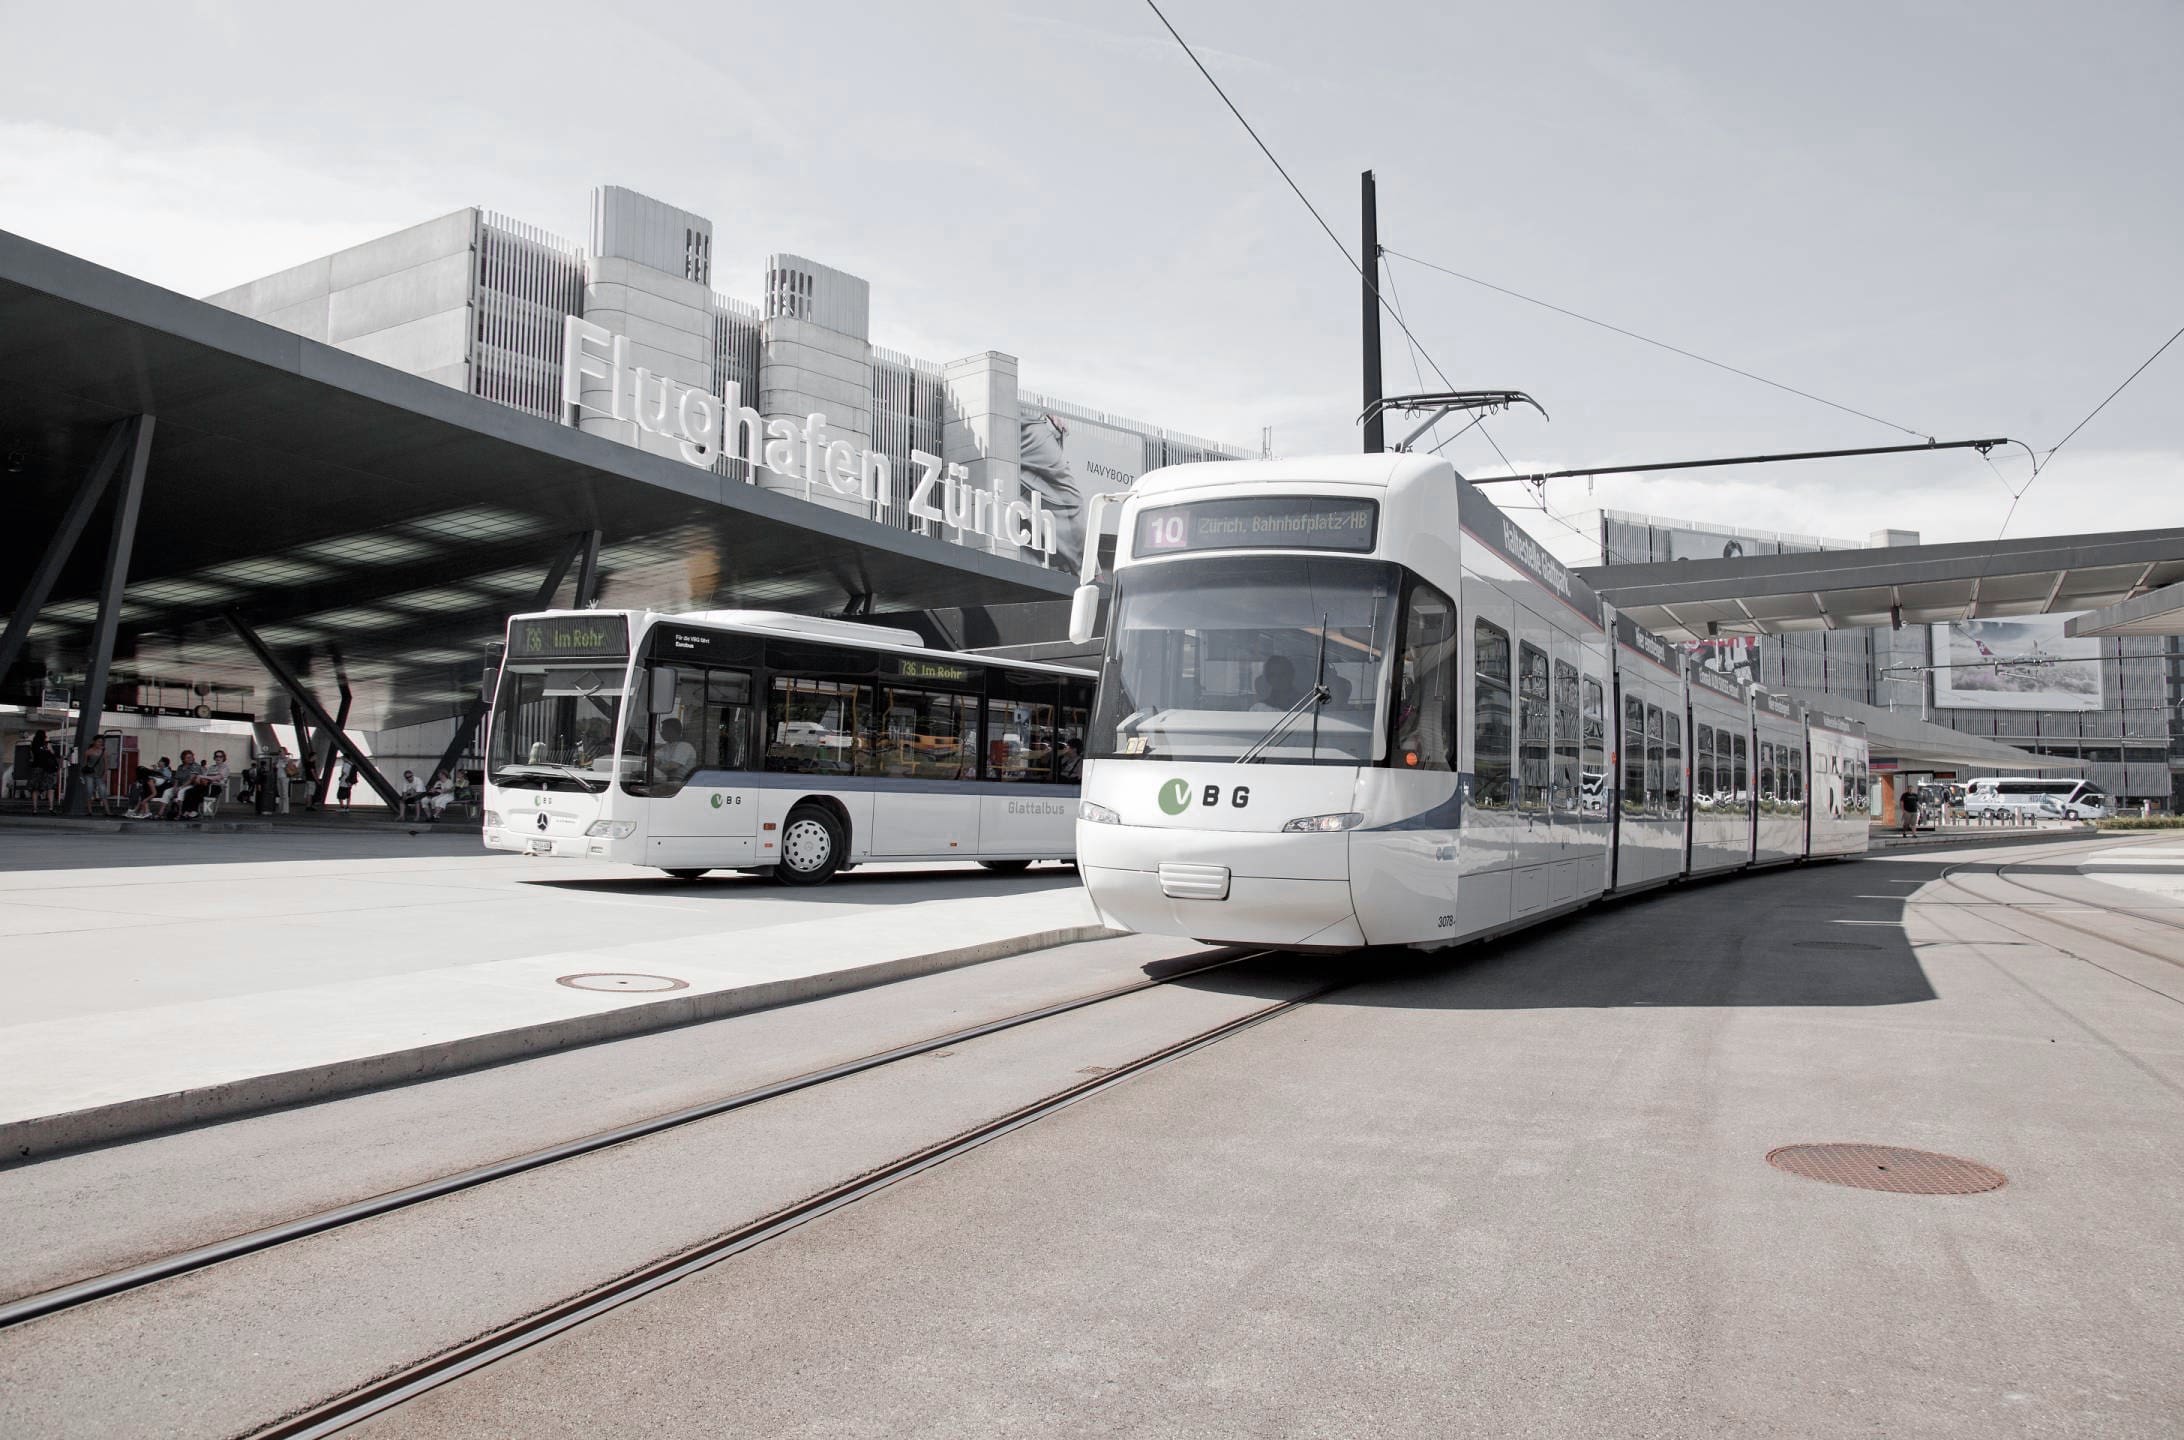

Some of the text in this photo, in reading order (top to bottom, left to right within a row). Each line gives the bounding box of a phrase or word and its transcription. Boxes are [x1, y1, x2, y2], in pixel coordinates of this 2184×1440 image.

[563, 315, 1057, 555] Flughafen Zürich
[1086, 460, 1135, 486] NAVYBOOT
[1151, 516, 1184, 544] 10
[1252, 511, 1368, 533] Bahnhofplatz/HB
[1502, 519, 1543, 576] Haltestelle
[554, 629, 571, 648] Im
[573, 627, 605, 648] Rohr
[901, 660, 963, 679] 736 Im Rohr
[1008, 801, 1065, 815] Glattalbus
